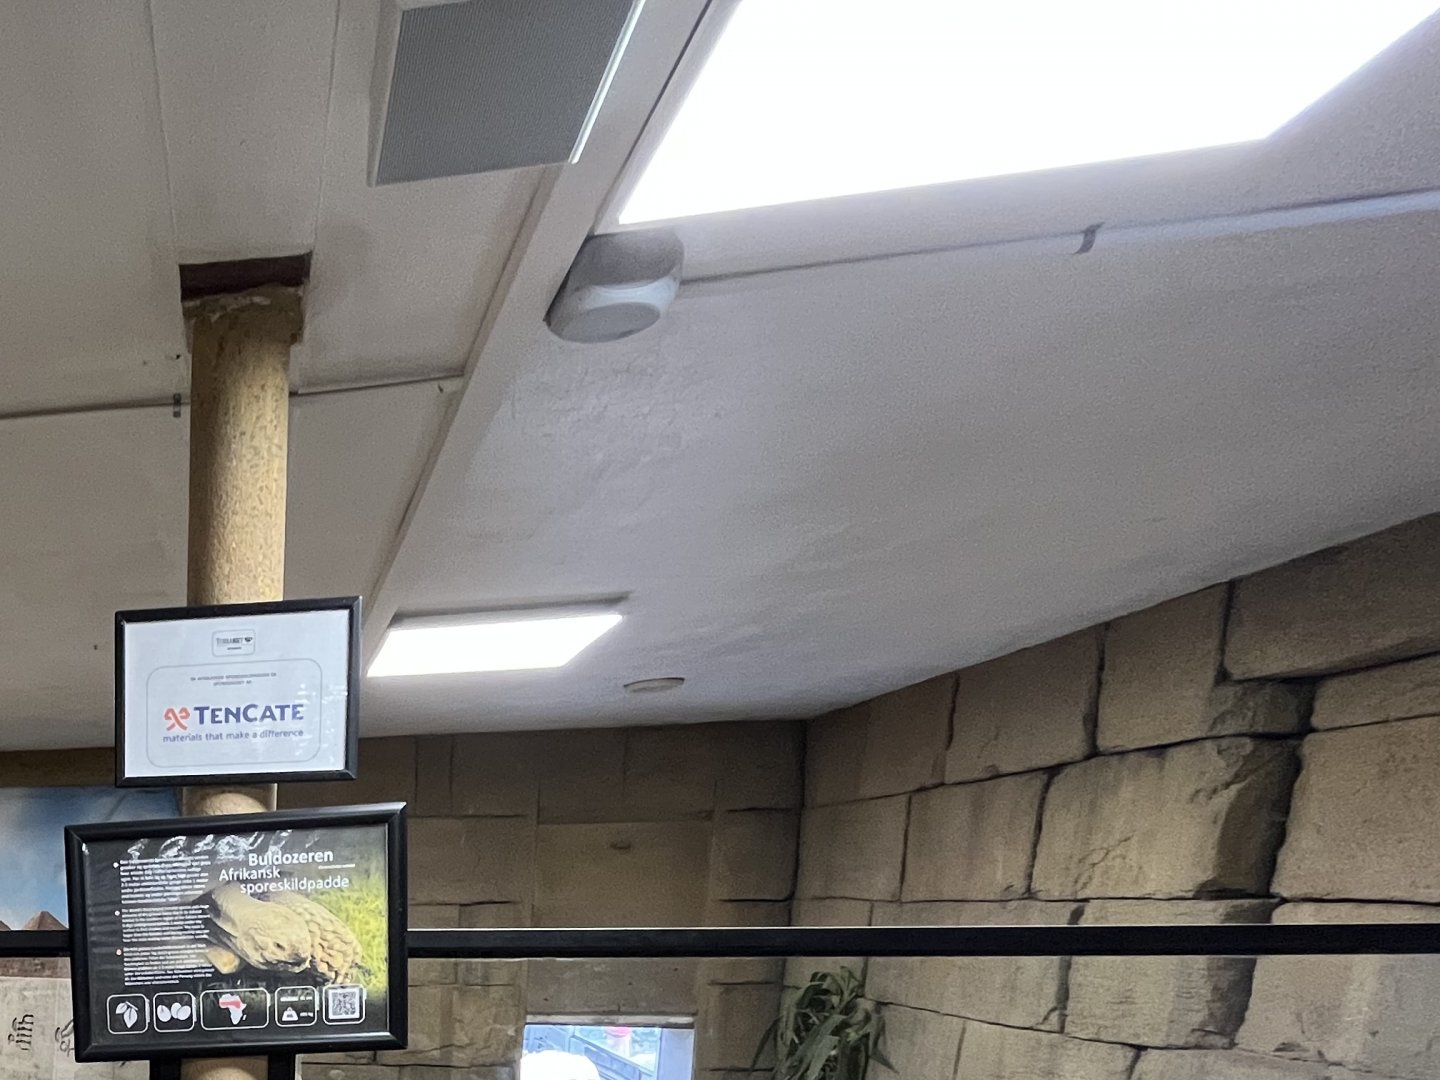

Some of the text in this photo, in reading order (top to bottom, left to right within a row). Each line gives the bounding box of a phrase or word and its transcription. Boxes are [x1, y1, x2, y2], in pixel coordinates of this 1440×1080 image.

[194, 704, 304, 725] TENCATE
[163, 733, 202, 743] materials
[205, 731, 223, 741] that
[226, 730, 250, 740] make
[259, 729, 304, 740] difference
[248, 850, 334, 866] Buldozeren
[219, 866, 281, 881] Afrikansk
[240, 875, 350, 895] sporeskildpadde
